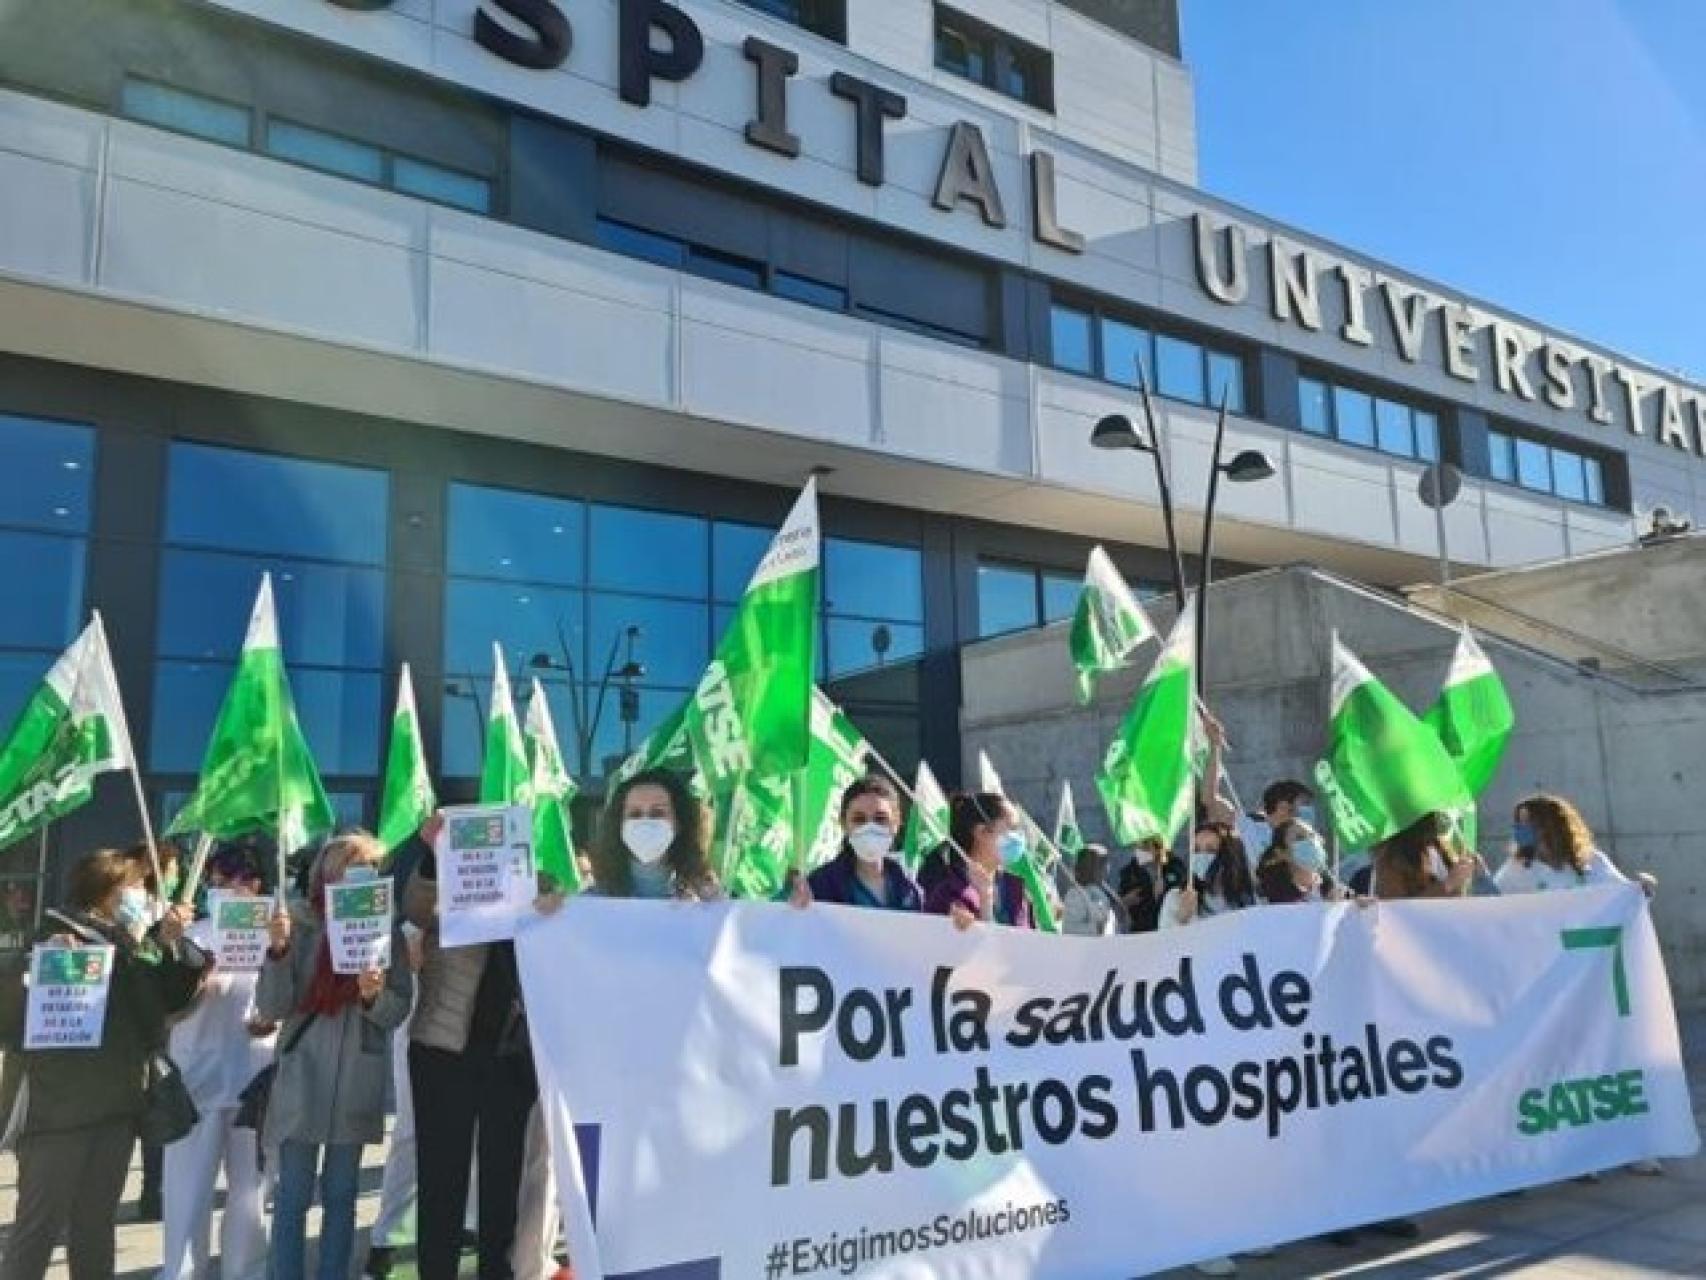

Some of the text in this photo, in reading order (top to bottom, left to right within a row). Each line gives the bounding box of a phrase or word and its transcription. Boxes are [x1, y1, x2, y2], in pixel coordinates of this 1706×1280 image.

[325, 0, 1085, 254] SPITAL
[779, 952, 1313, 1067] Por la salud de
[771, 1023, 1464, 1188] nuestros hospitales
[1516, 1069, 1650, 1136] SATSE
[764, 1197, 1072, 1280] #ExigimosSoluciones
